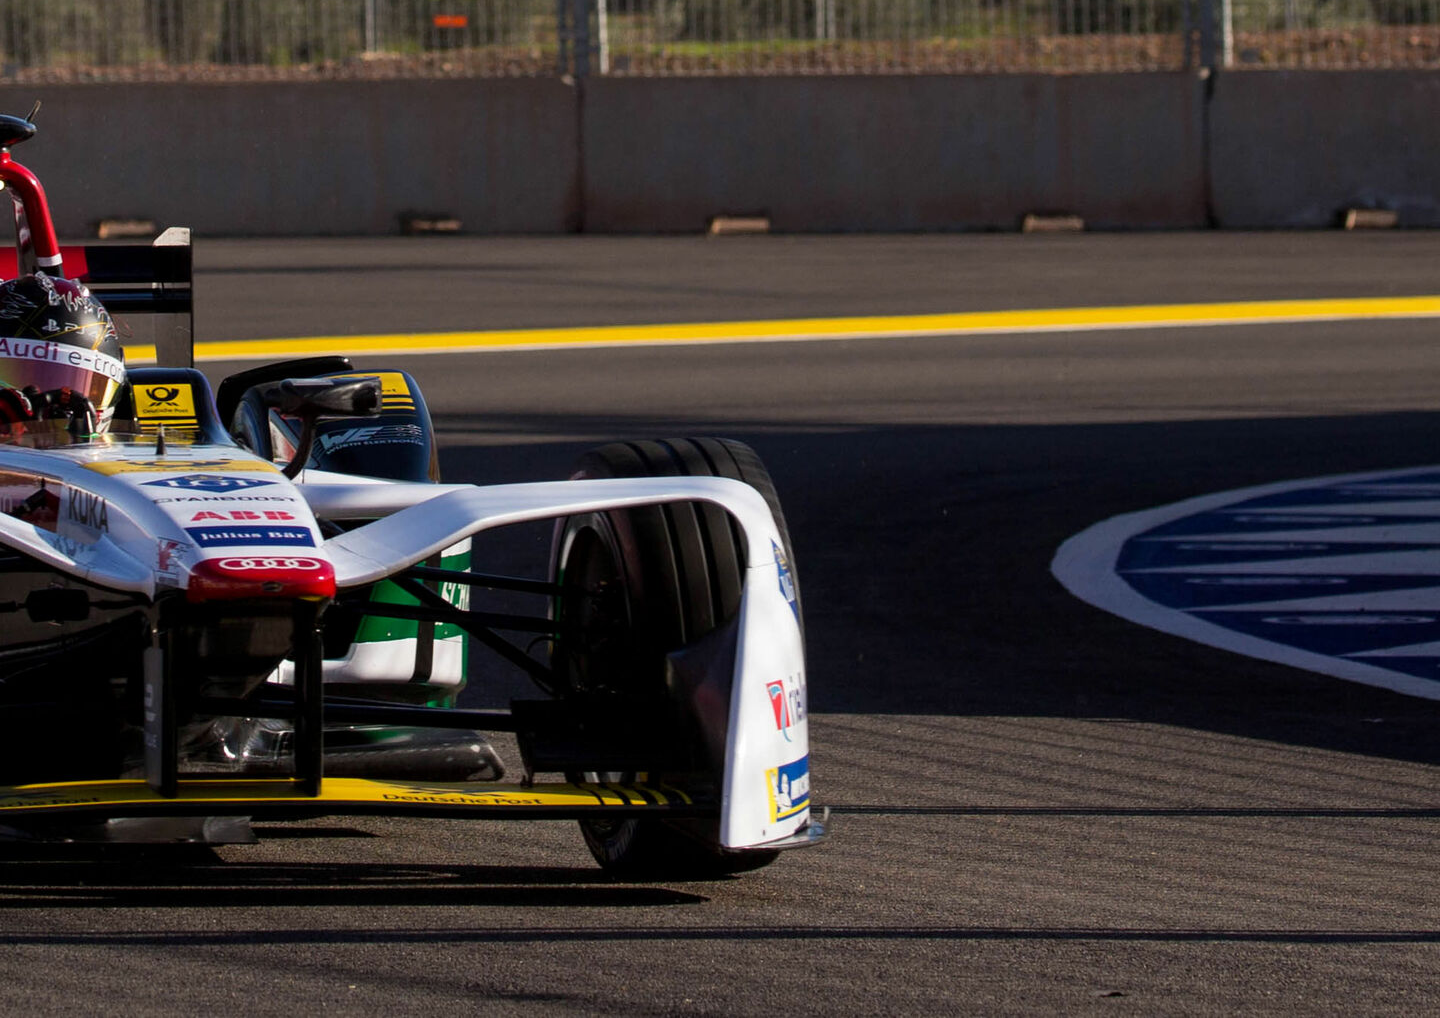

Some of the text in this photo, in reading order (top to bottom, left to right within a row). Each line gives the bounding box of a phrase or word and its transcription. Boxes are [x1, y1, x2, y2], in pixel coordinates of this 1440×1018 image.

[320, 426, 383, 450] WE
[68, 487, 109, 533] KUKA
[190, 510, 296, 522] ABB
[200, 531, 307, 541] Julius Bär
[383, 794, 488, 804] Deutsche
